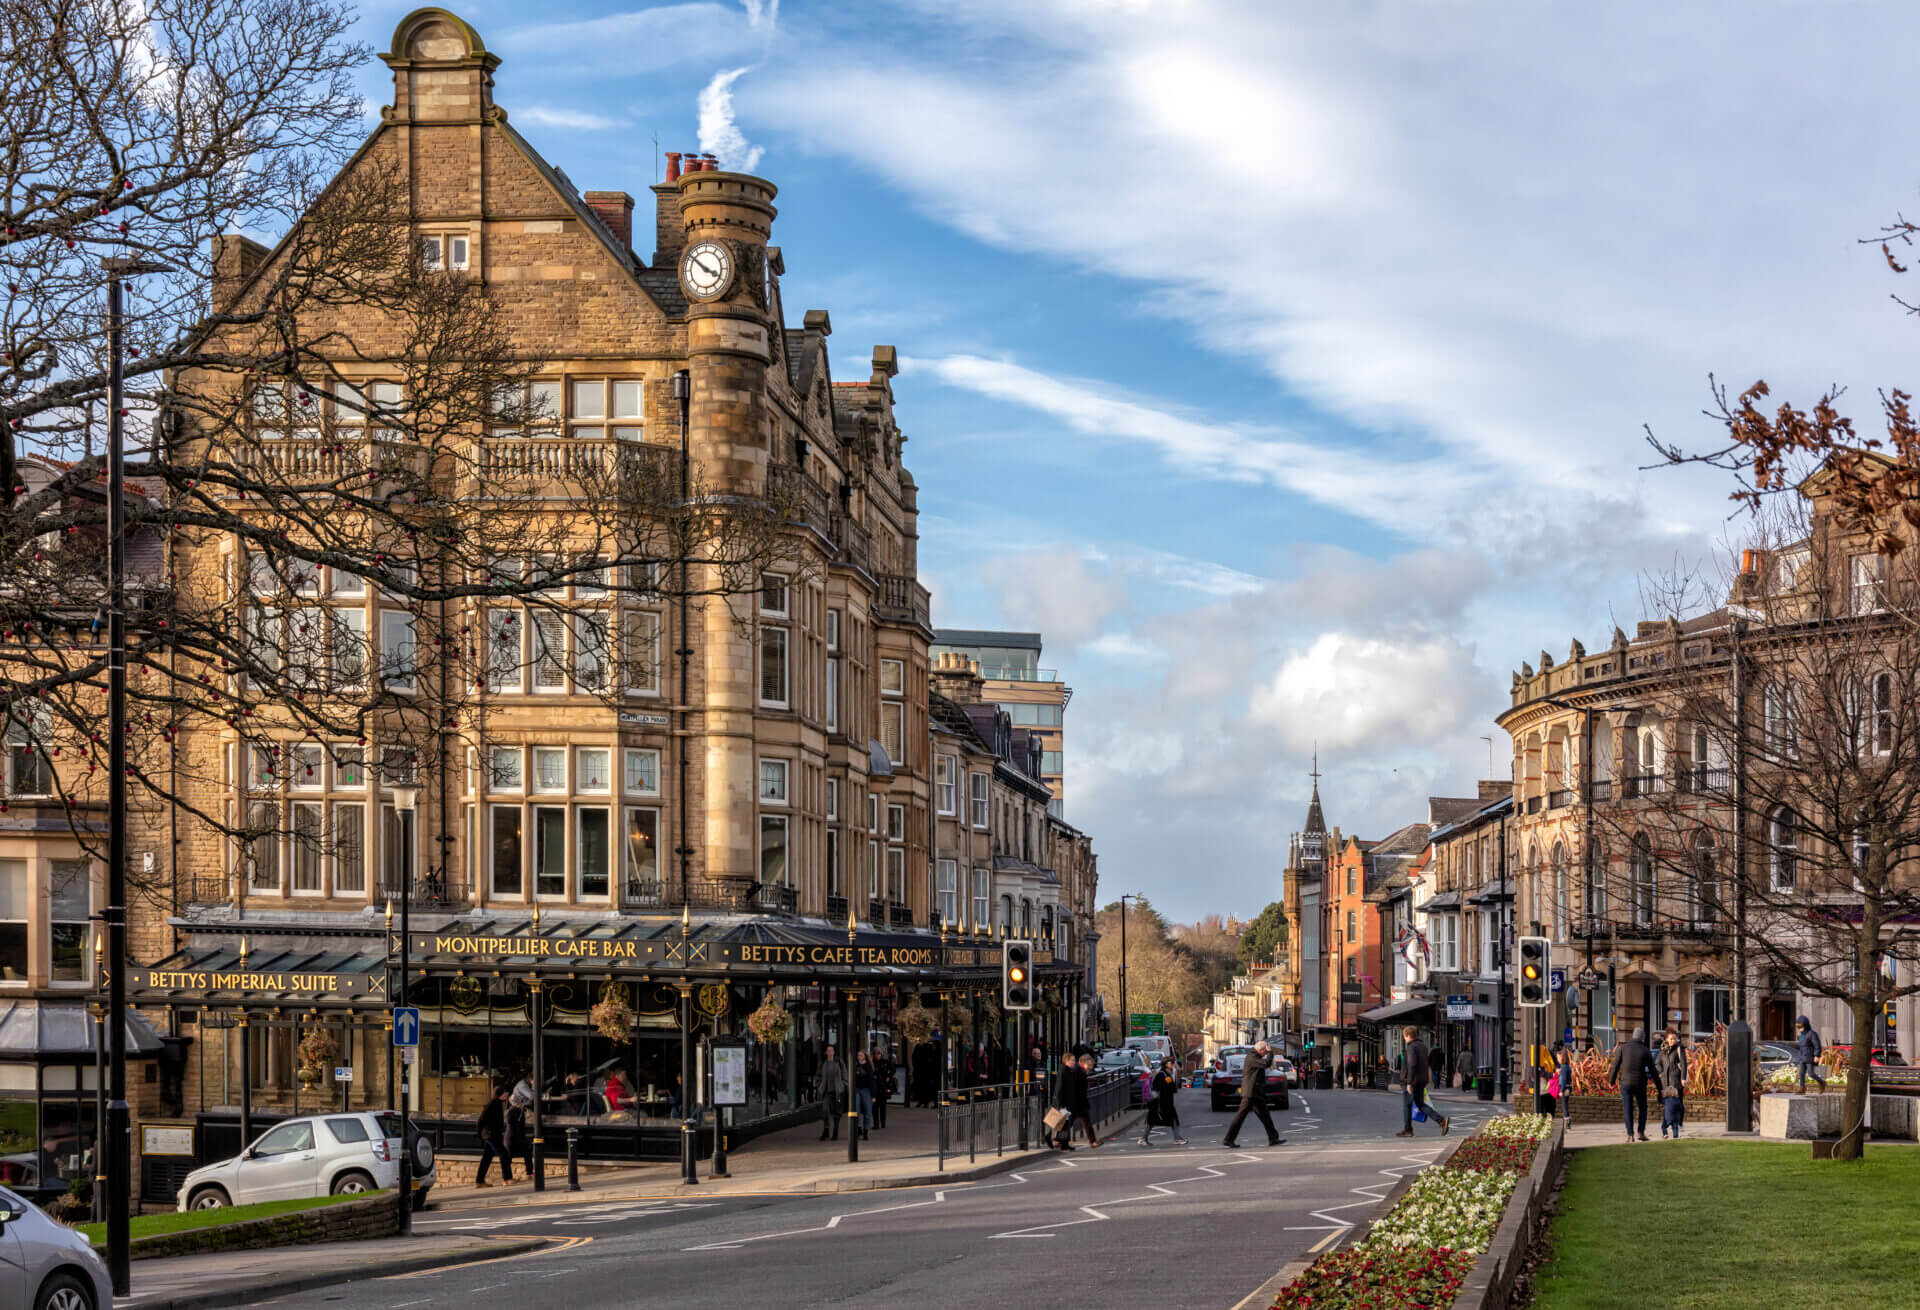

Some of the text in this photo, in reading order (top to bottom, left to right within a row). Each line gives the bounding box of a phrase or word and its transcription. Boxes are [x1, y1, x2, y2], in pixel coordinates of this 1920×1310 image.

[436, 937, 637, 957] MONTPELLIER CAFE BAR
[741, 945, 932, 964] BETTYS CAFE TEA ROOMS
[150, 972, 337, 991] BETTYS IMPERIAL SUITE
